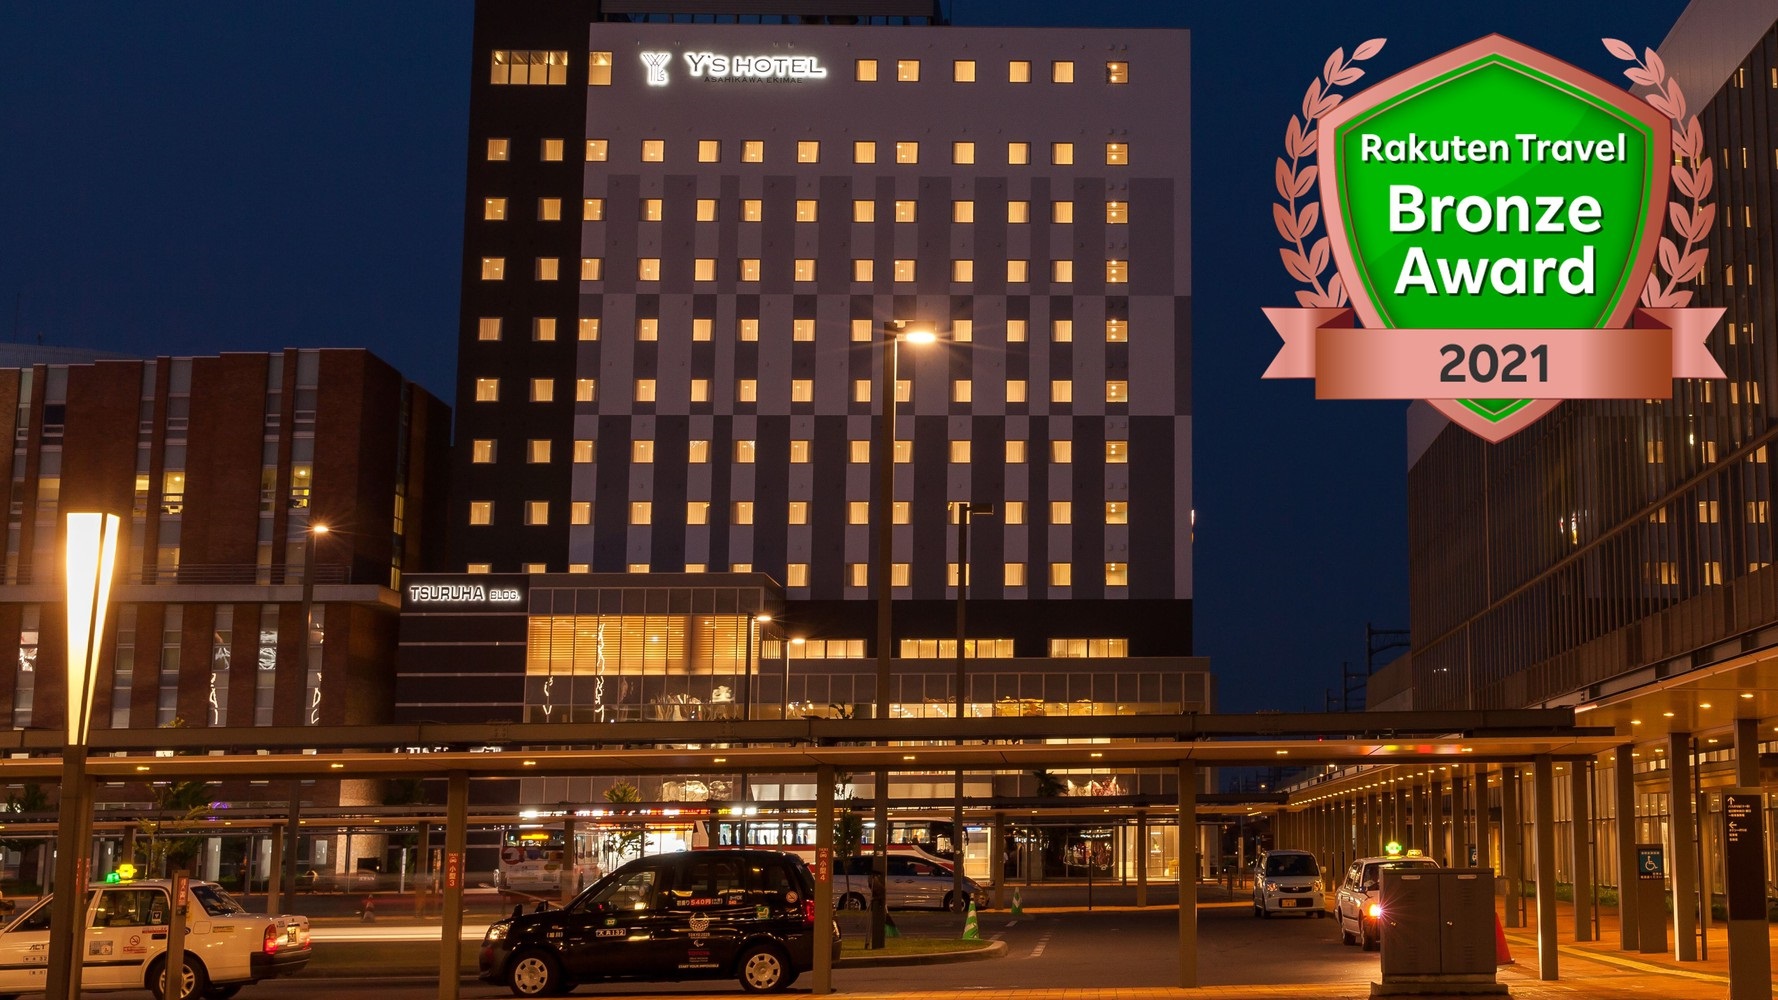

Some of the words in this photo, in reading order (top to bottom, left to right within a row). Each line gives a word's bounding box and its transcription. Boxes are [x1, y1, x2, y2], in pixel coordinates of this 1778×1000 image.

[735, 57, 824, 74] HOTEL
[703, 76, 762, 84] ASAHIKAWA
[766, 76, 803, 84] EKIMAE
[410, 586, 484, 600] TSURUHA
